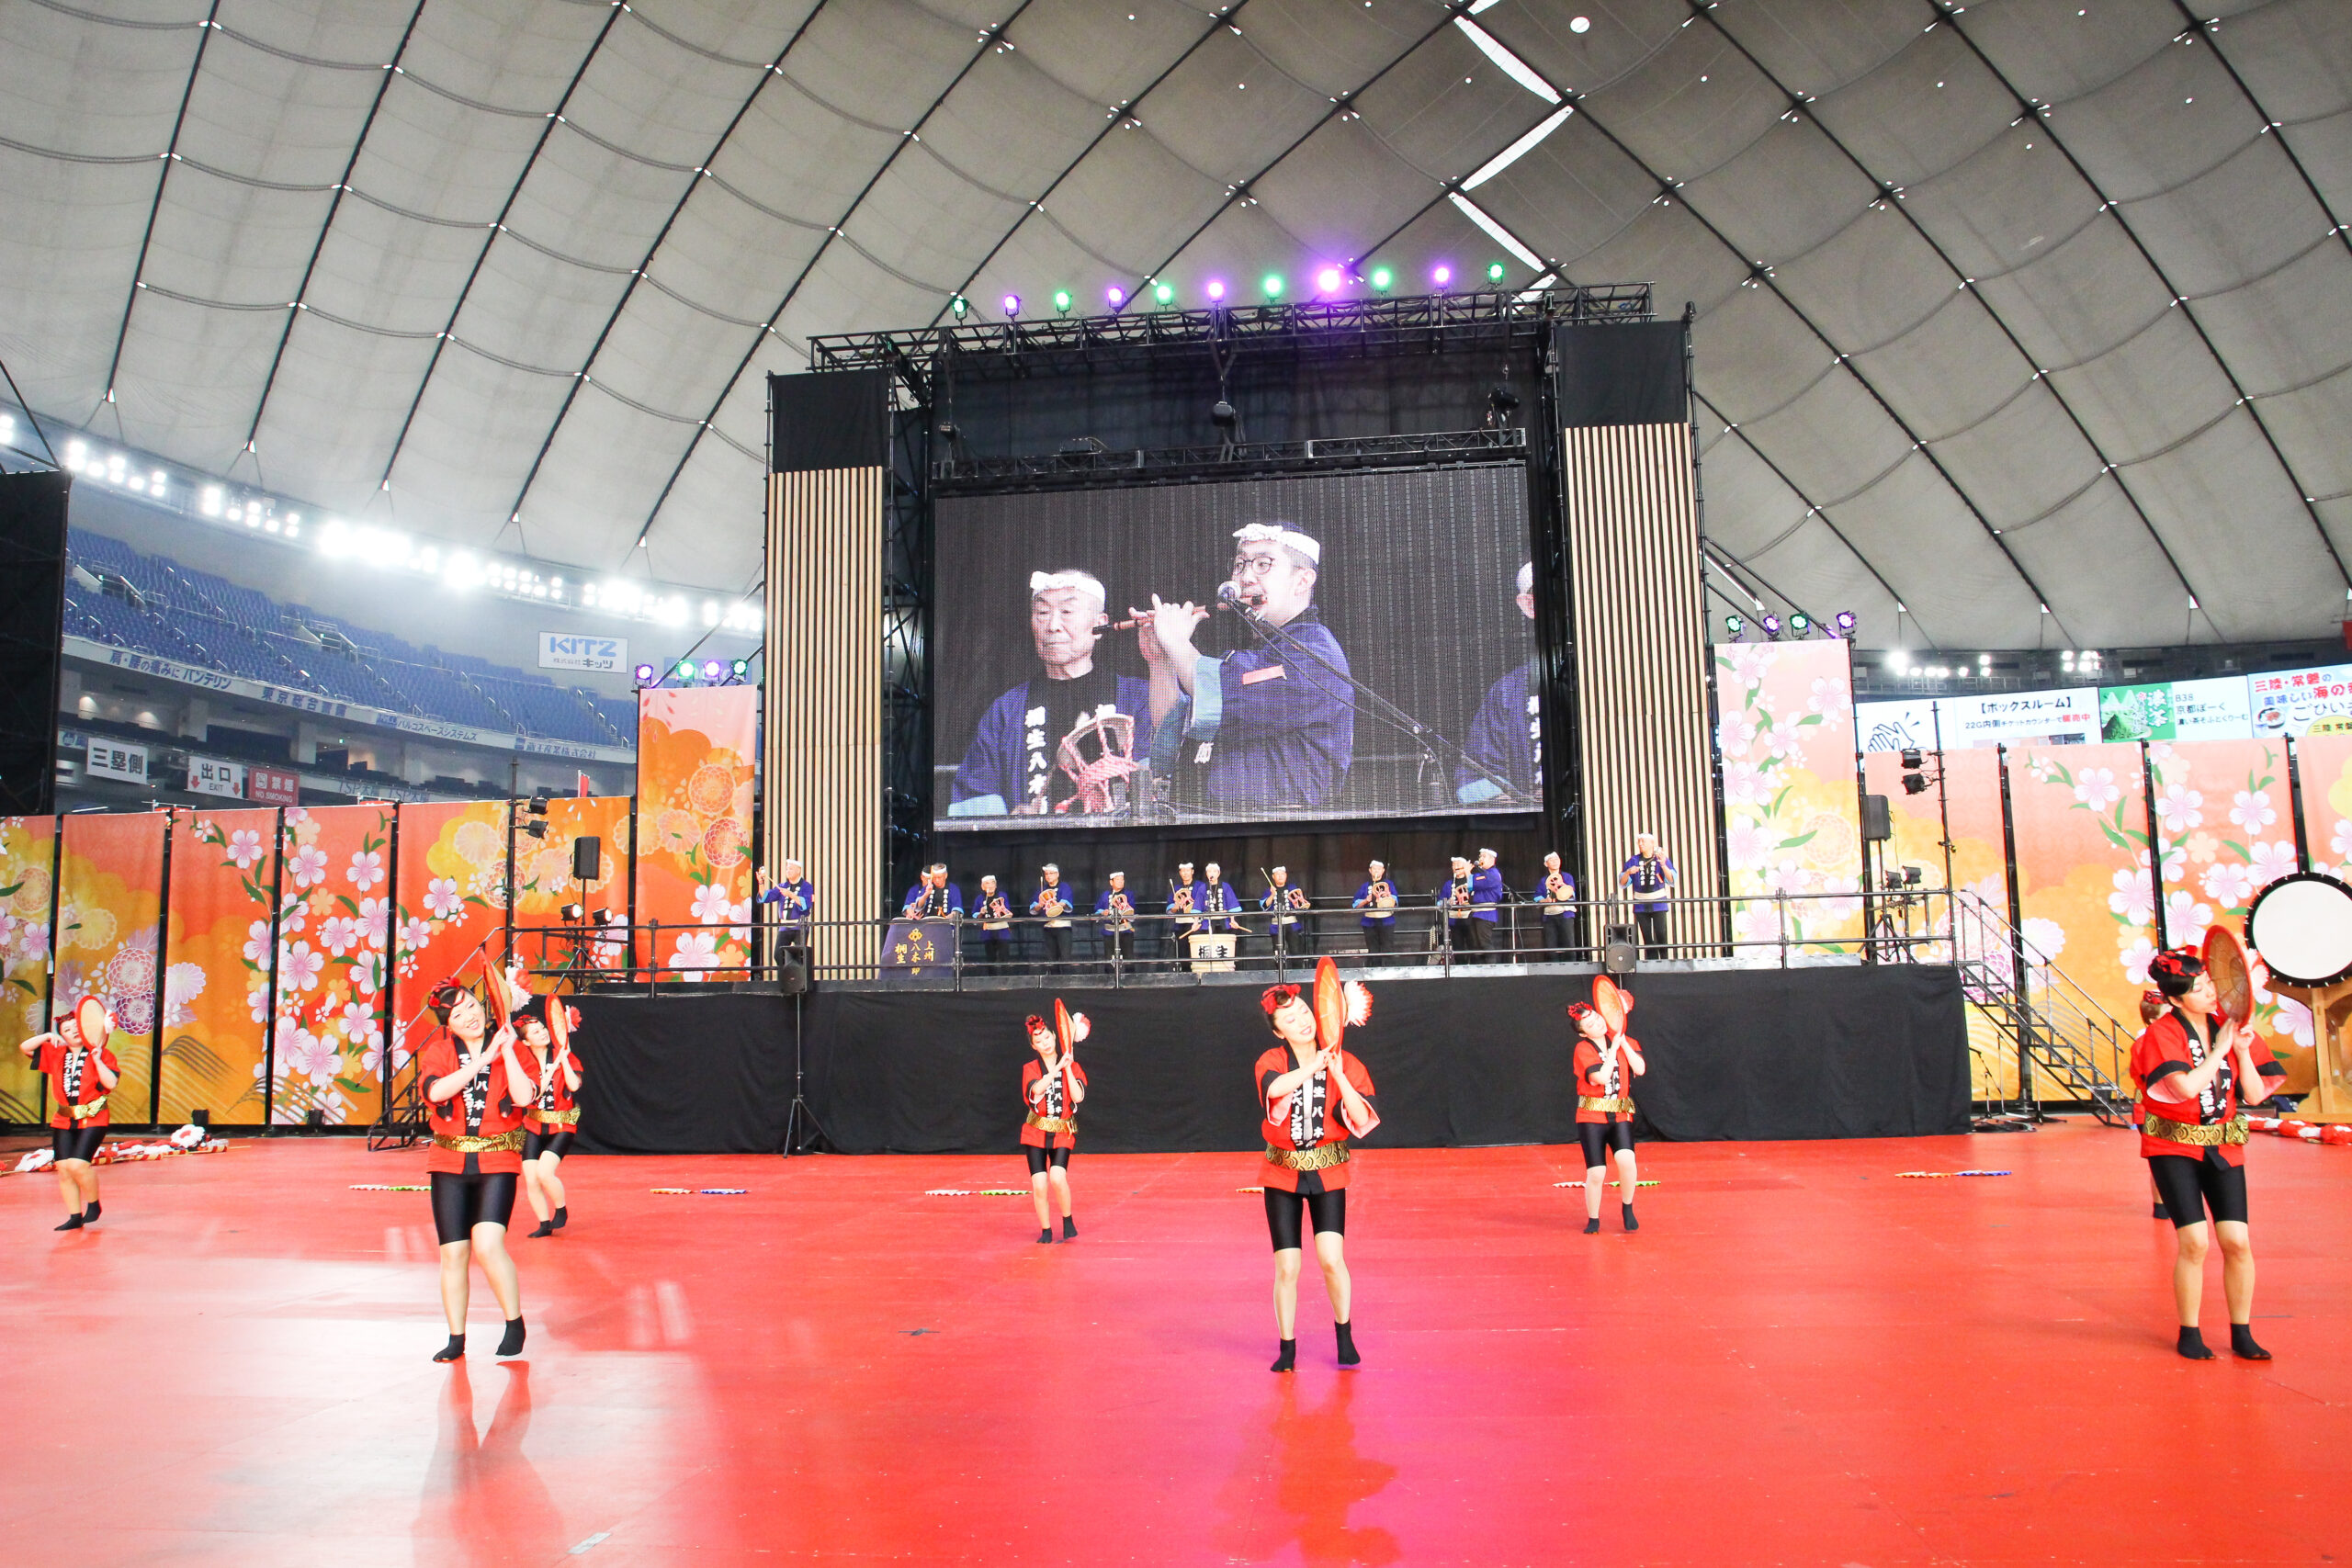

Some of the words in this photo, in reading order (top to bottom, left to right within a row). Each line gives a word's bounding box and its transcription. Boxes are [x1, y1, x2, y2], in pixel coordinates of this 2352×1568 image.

[549, 637, 617, 658] KITZ
[183, 668, 232, 689] バンテリン
[2175, 694, 2194, 702] B38
[92, 747, 144, 775] 三塁側
[201, 762, 231, 783] 出口
[209, 783, 223, 792] EXIT
[272, 776, 294, 792] 禁煙
[255, 790, 265, 798] NO
[266, 791, 293, 803] SMOKING
[924, 941, 934, 962] 上州
[1199, 945, 1228, 959] 桐生
